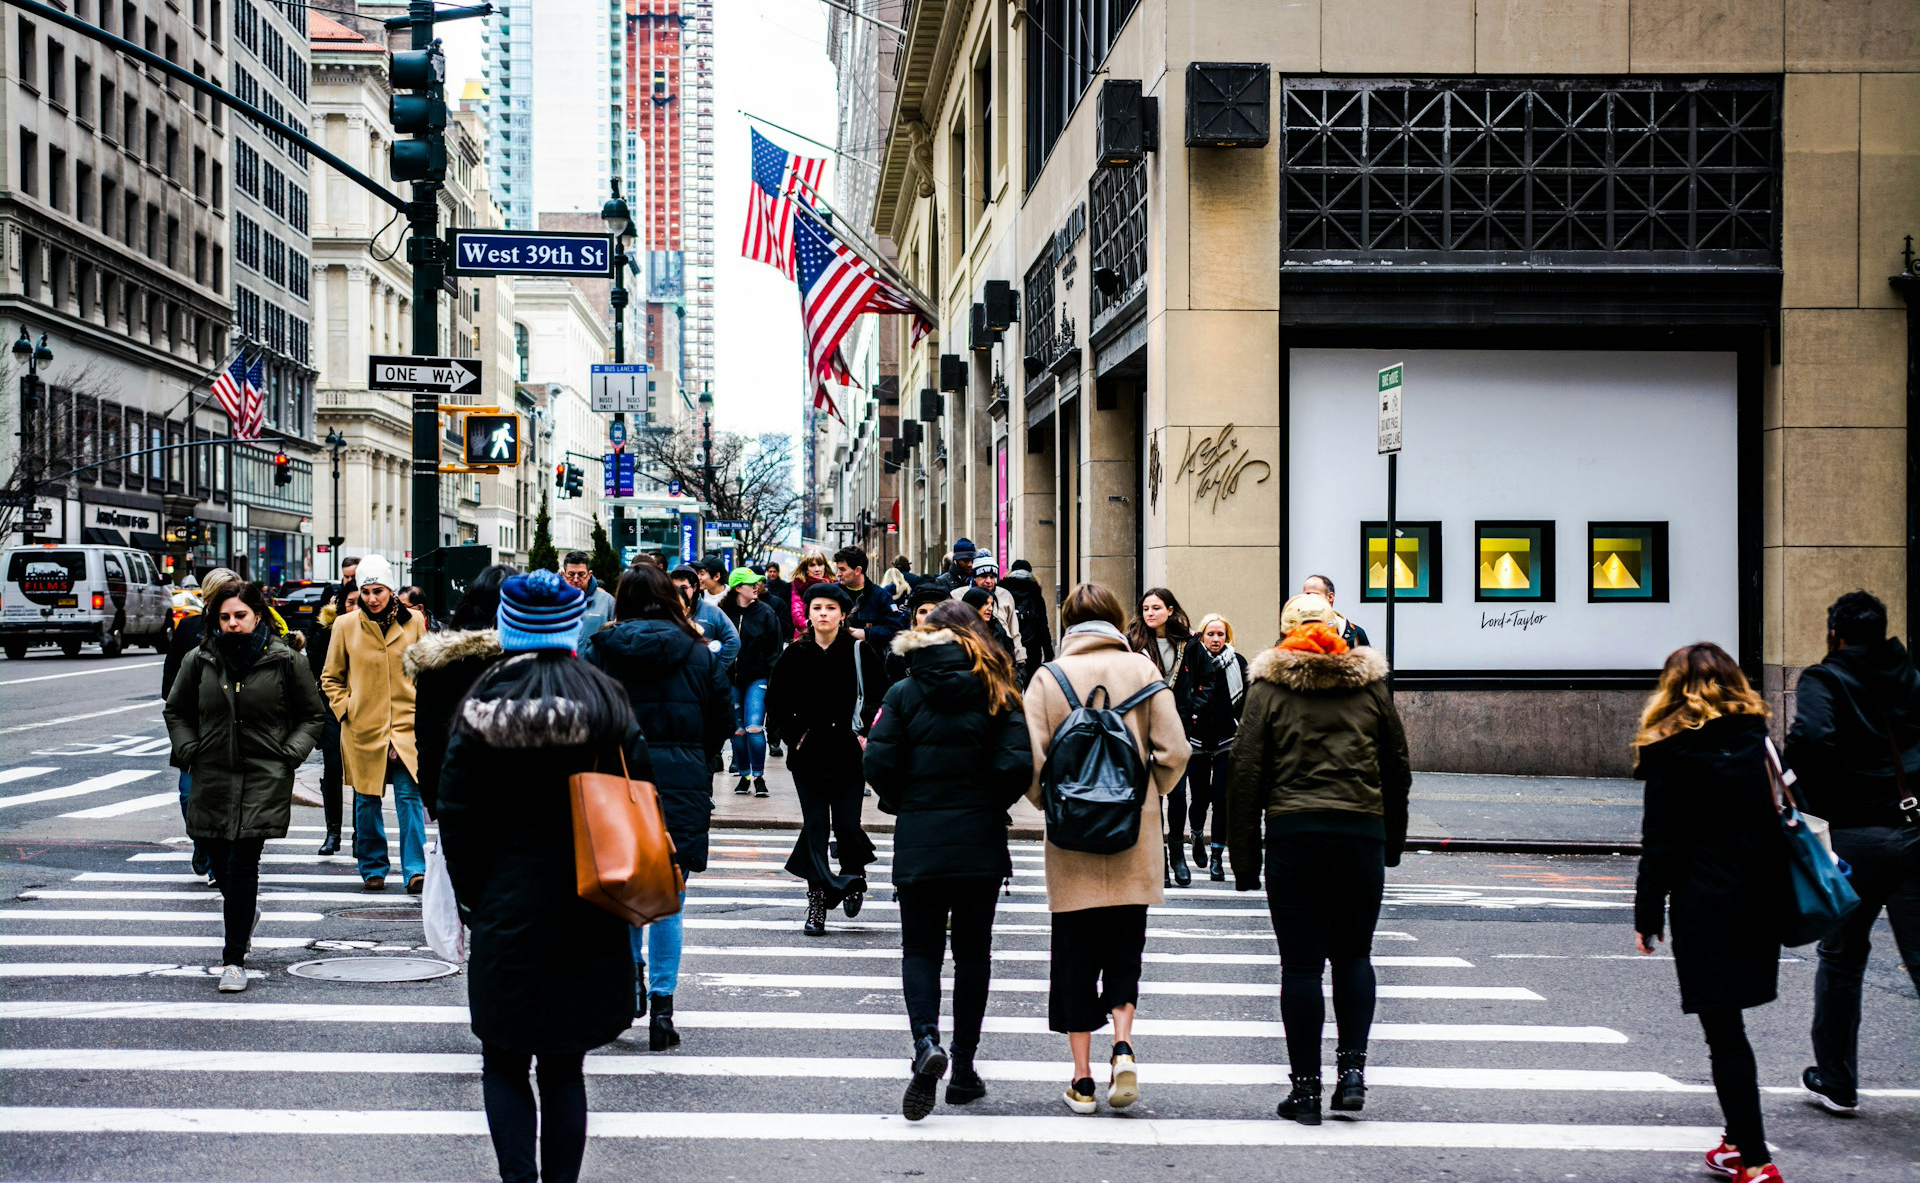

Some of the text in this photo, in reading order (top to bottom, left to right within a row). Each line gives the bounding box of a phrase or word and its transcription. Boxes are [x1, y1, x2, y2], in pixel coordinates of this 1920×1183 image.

[462, 243, 604, 266] West 39th St
[385, 366, 465, 384] ONE WAY
[25, 582, 68, 590] FILMS
[1481, 611, 1506, 629] Lord
[1510, 609, 1548, 631] Taylor
